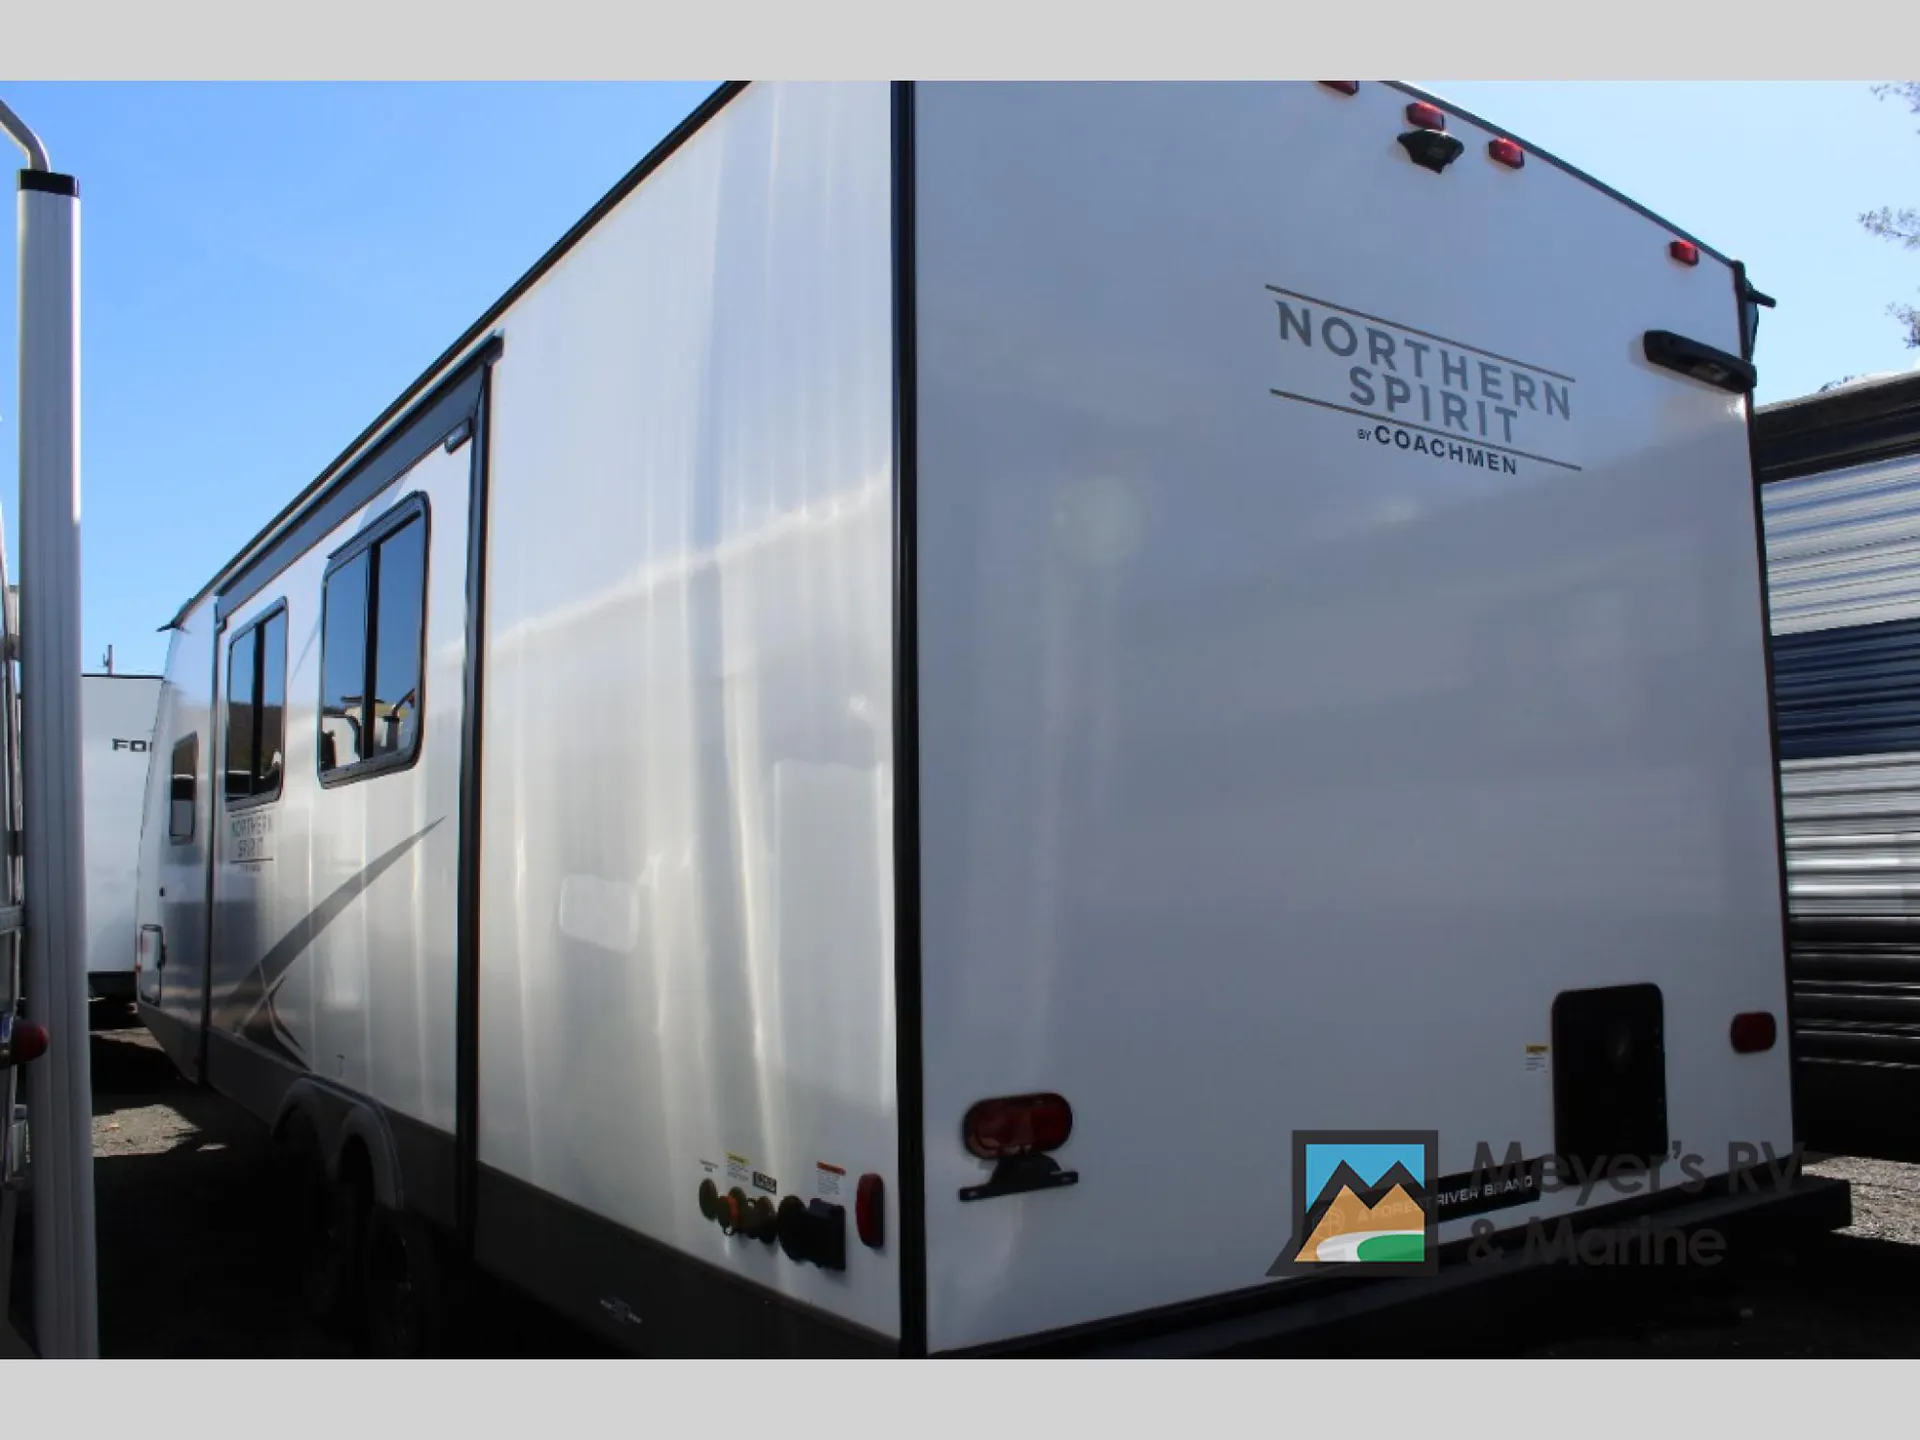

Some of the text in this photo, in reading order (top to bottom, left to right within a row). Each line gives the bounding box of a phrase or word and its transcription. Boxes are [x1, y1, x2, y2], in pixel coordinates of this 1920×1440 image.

[1275, 299, 1571, 420] NORTHERN
[1349, 366, 1519, 443] SPIRIT
[1374, 424, 1518, 475] COACHMEN
[1484, 1174, 1534, 1197] BRAND
